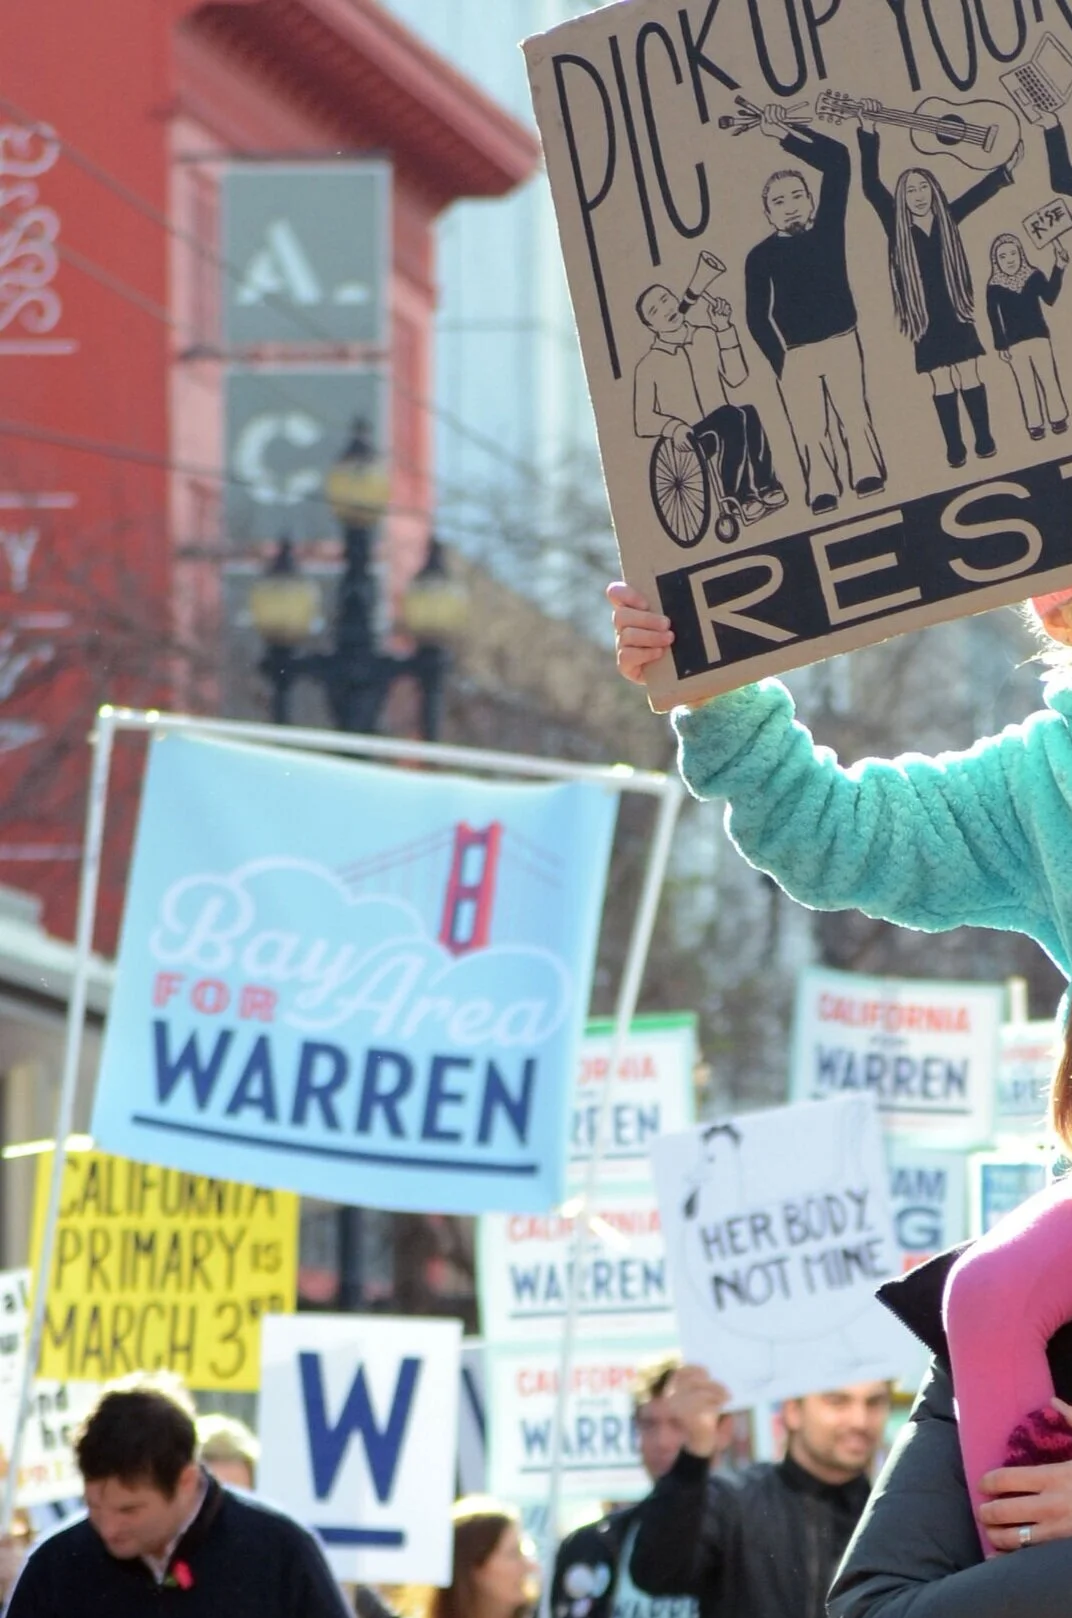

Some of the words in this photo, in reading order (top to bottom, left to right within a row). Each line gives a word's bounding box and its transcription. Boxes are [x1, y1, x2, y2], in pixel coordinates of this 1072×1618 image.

[552, 0, 741, 380] PICK
[150, 866, 357, 1010] Bay
[283, 945, 556, 1047] Area
[152, 971, 277, 1023] FOR
[817, 991, 970, 1032] CALIFORNIA
[152, 1019, 537, 1147] WARREN
[814, 1042, 969, 1099] WARREN
[55, 1225, 247, 1293] PRIMARY
[250, 1239, 284, 1274] IS
[701, 1209, 778, 1263] HER
[712, 1254, 790, 1312] NOT
[803, 1236, 891, 1295] MINE
[36, 1299, 197, 1378] MARCH
[292, 1348, 424, 1506] W
